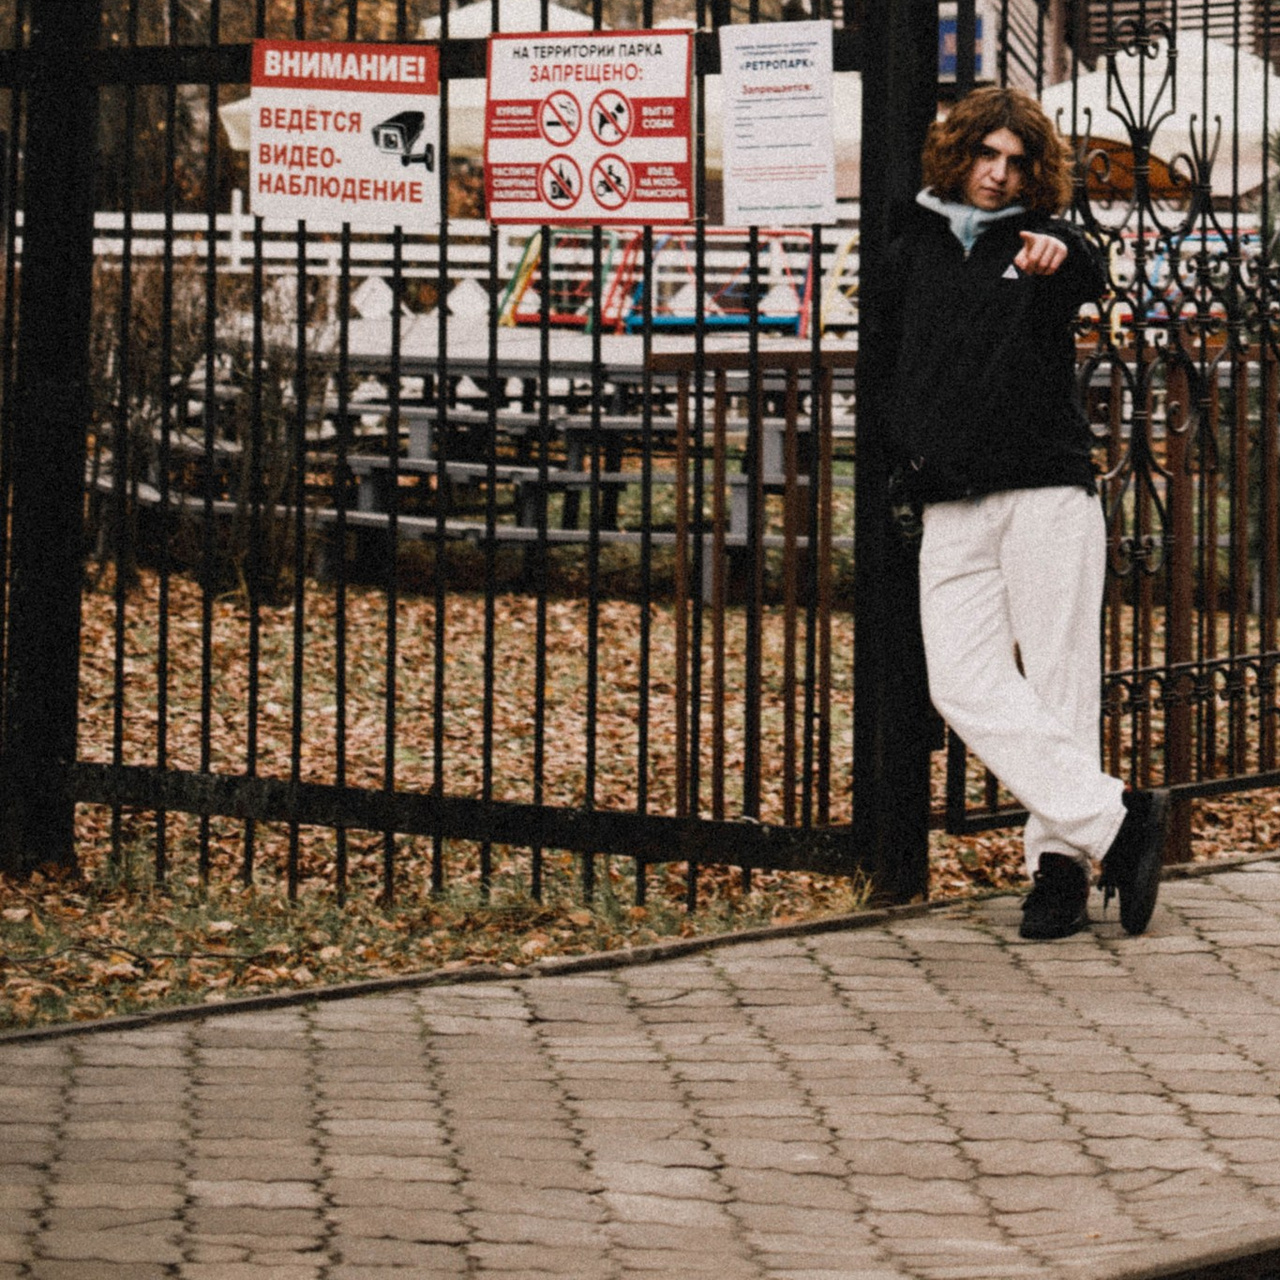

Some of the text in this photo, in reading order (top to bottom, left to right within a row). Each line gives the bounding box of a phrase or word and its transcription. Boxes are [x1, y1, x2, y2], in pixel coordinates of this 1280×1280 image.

[512, 43, 663, 59] НА ТЕРРИТОРИИ ПАРКА
[264, 49, 427, 83] ВНИМАНИЕ!
[529, 63, 644, 84] ЗАПРЕЩЕНО:
[259, 105, 362, 134] ВЕДЁТСЯ
[641, 105, 675, 117] ВЫГУЛ
[641, 118, 675, 130] СОБАК
[258, 143, 342, 170] ВИДЕО-
[258, 173, 423, 204] НАБЛЮДЕНИЕ
